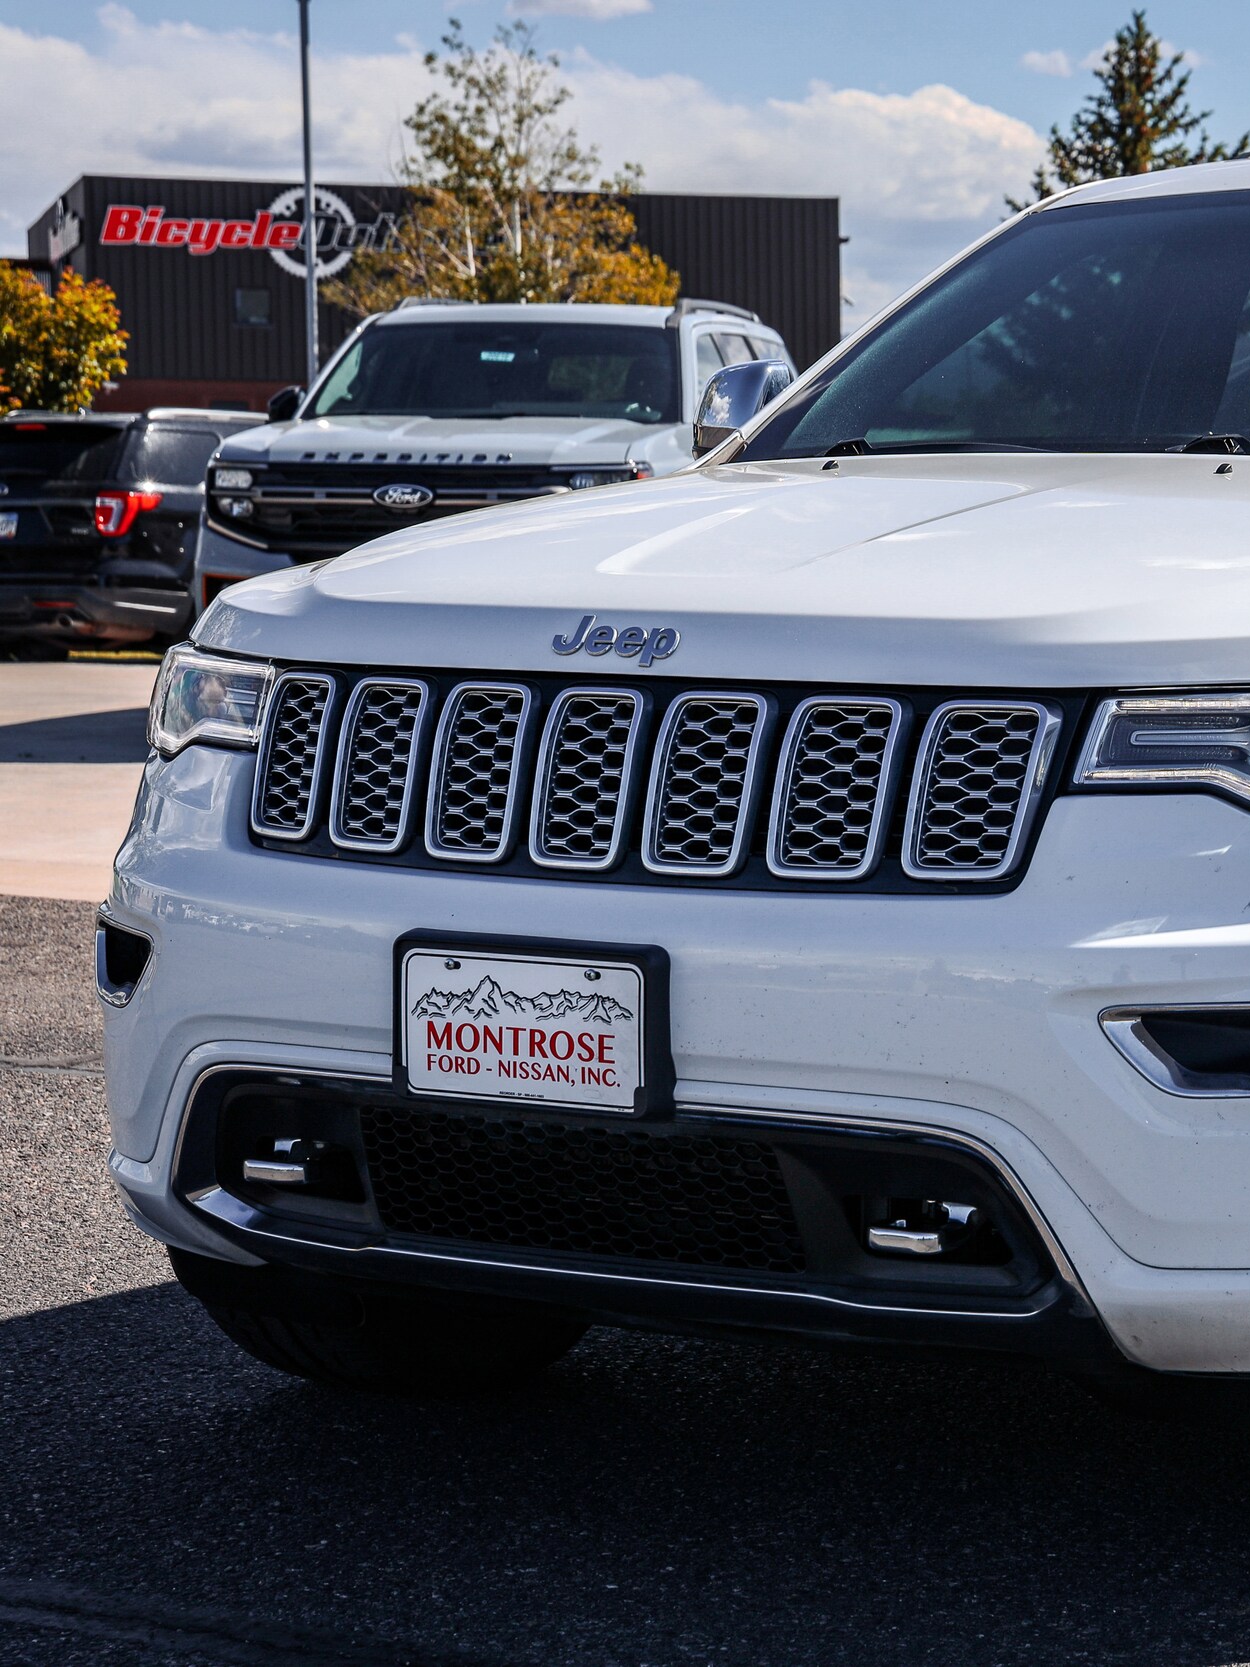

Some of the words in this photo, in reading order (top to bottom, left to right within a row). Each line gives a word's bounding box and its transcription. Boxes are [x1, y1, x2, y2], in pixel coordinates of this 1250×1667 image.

[101, 204, 302, 255] Bicycle
[301, 451, 512, 463] EXPEDITION
[551, 614, 681, 667] Jeep
[426, 1020, 616, 1064] MONTROSE
[426, 1053, 481, 1075] FORD
[498, 1059, 576, 1088] NISSAN,
[581, 1068, 621, 1088] INC.
